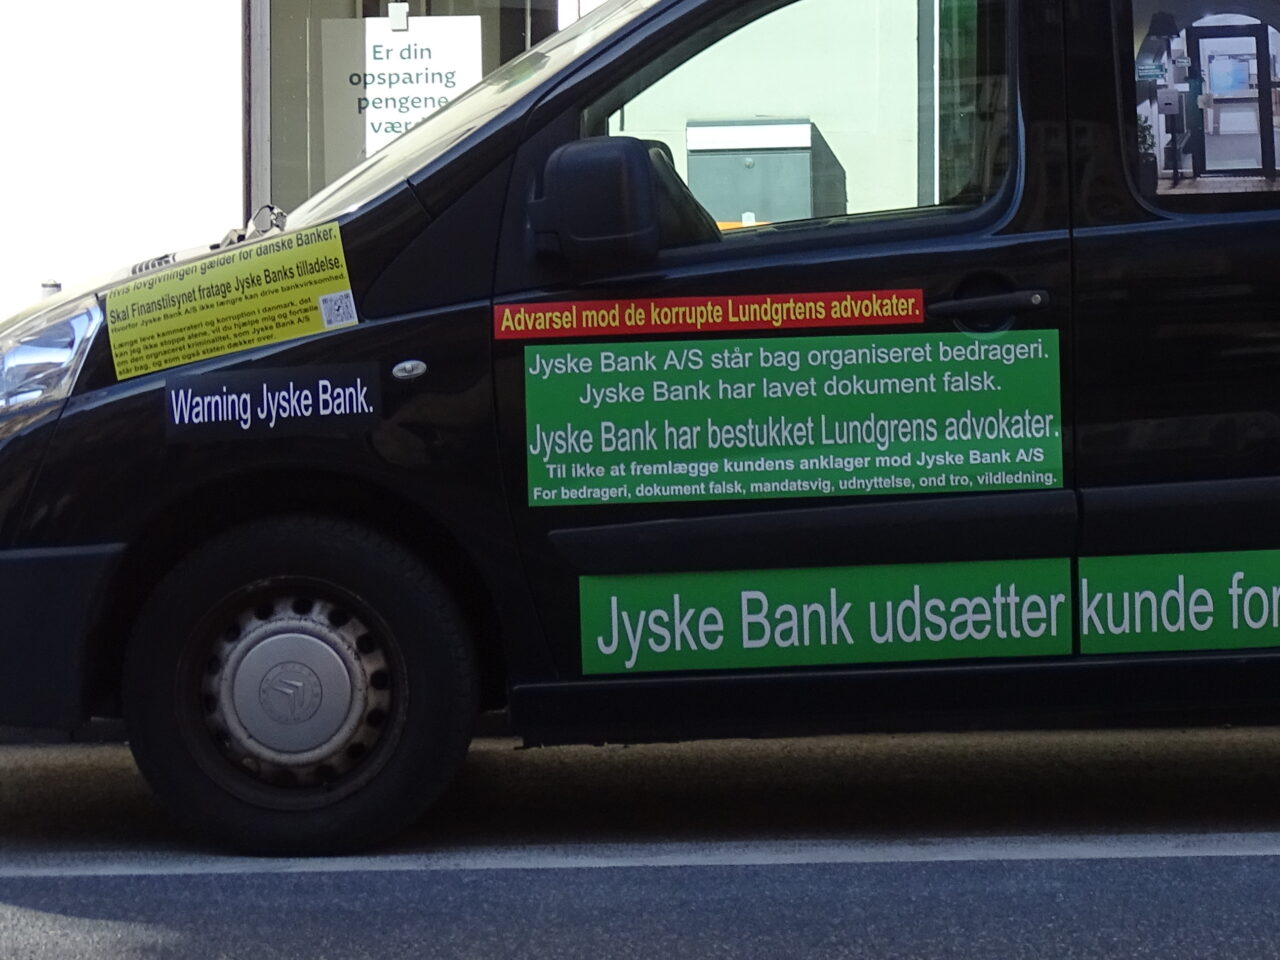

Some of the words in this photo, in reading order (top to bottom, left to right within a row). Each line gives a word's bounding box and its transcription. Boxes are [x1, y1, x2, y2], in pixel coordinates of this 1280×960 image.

[372, 44, 393, 61] Er
[399, 43, 432, 61] din
[348, 67, 456, 89] opsparing
[357, 96, 449, 114] pengene
[109, 307, 130, 325] Skal
[131, 290, 198, 316] Finanstilsynet
[198, 281, 232, 301] fratage
[234, 274, 263, 296] Jyske
[264, 265, 295, 285] Banks
[296, 256, 344, 278] tilladelse.
[500, 304, 577, 331] Advarsel
[581, 302, 619, 328] mod
[624, 302, 646, 326] de
[650, 300, 723, 329] korrupte
[727, 296, 826, 327] Lundgrtens
[829, 292, 920, 319] advokater.
[527, 352, 593, 380] Jyske
[599, 349, 657, 372] Bank
[662, 347, 704, 370] A/S
[710, 345, 753, 369] står
[758, 346, 801, 372] bag
[806, 342, 932, 370] organiseret
[938, 337, 1049, 365] bedrageri.
[171, 386, 251, 430] Warning
[257, 381, 313, 428] Jyske
[319, 378, 374, 417] Bank.
[528, 422, 593, 463] Jyske
[599, 419, 658, 452] Bank
[663, 418, 701, 450] har
[706, 414, 815, 449] bestukket
[820, 411, 938, 451] Lundgrens
[944, 407, 1059, 441] advokater.
[544, 463, 566, 478] Til
[570, 462, 605, 477] ikke
[608, 462, 626, 477] at
[629, 459, 719, 477] fremlægge
[722, 456, 795, 473] kundens
[798, 454, 871, 472] anklager
[874, 451, 912, 468] mod
[915, 450, 964, 469] Jyske
[968, 448, 1011, 464] Bank
[1014, 446, 1045, 463] A/S
[532, 486, 558, 500] For
[559, 483, 632, 501] bedrageri,
[634, 481, 706, 497] dokument
[707, 479, 746, 495] falsk,
[749, 477, 835, 493] mandatsvig,
[838, 474, 915, 492] udnyttelse,
[918, 472, 946, 487] ond
[948, 473, 973, 487] tro,
[975, 469, 1057, 486] vildledning.
[596, 592, 724, 669] Jyske
[740, 586, 854, 649] Bank
[868, 582, 1066, 644] udsætter
[1081, 573, 1214, 635] kunde
